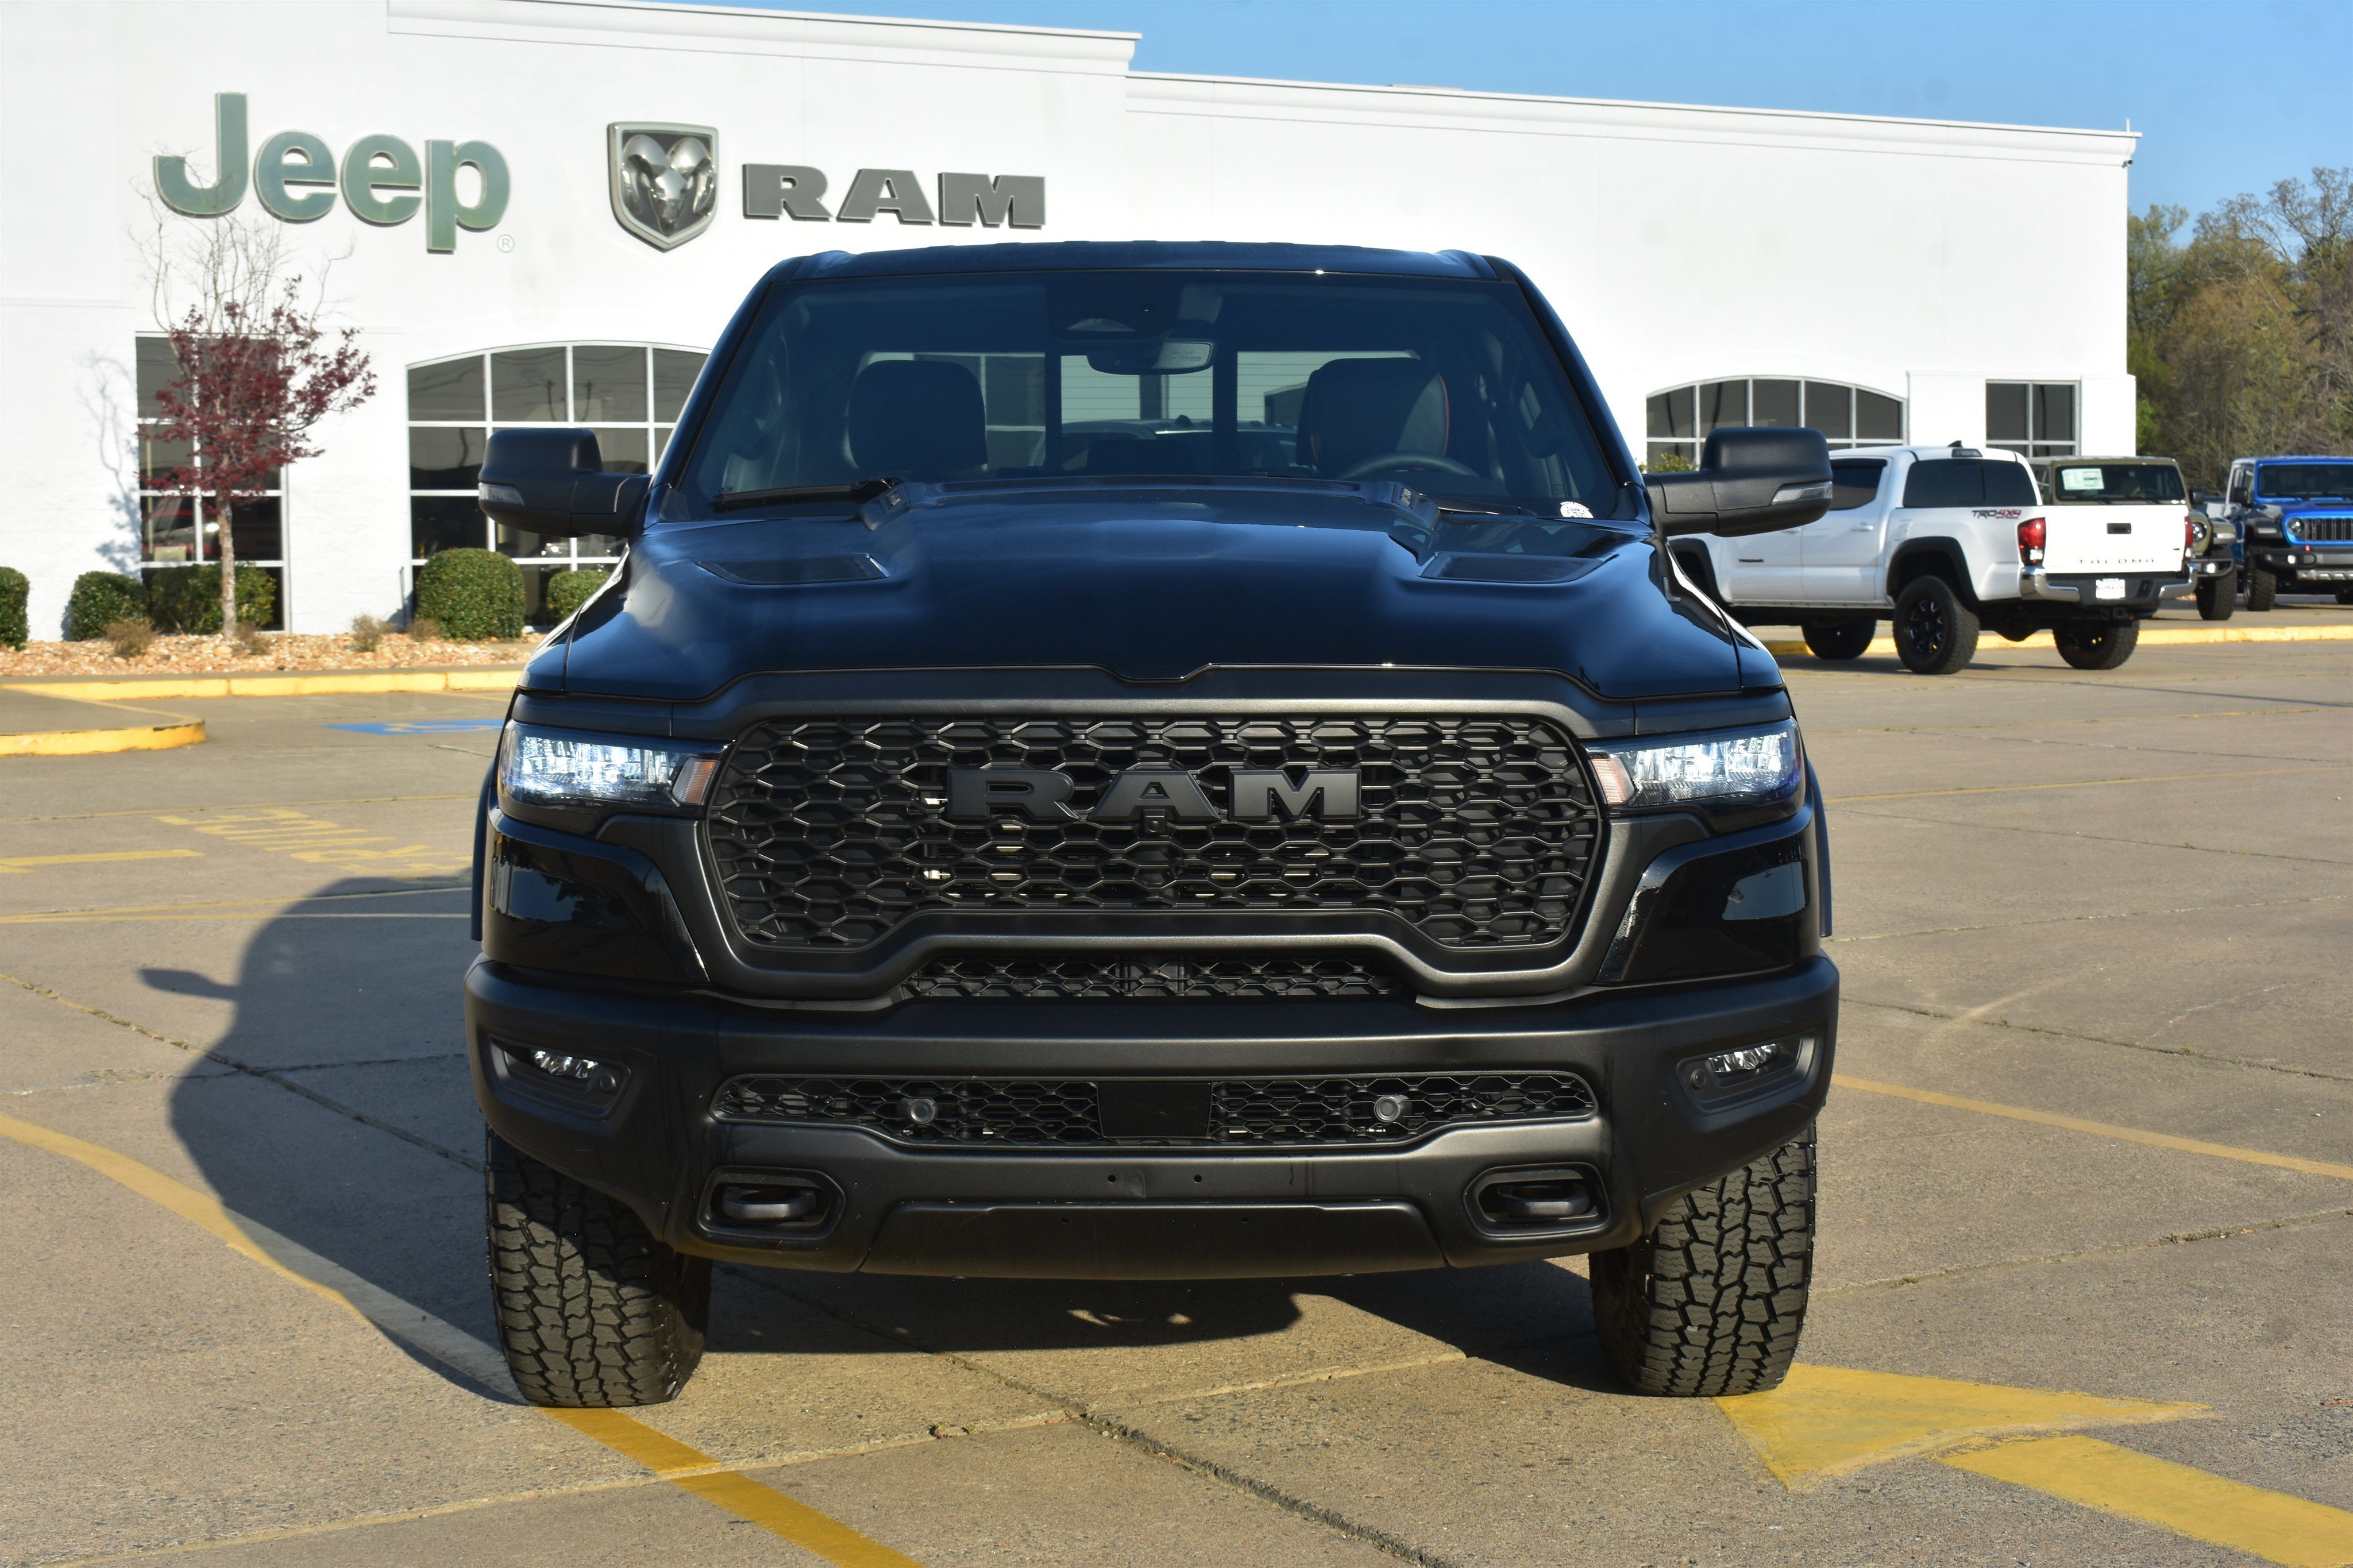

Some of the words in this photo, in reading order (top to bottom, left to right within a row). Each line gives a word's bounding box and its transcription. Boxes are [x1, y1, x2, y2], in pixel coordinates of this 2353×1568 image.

[153, 92, 510, 254] Jeep
[742, 163, 1047, 229] RAM
[947, 769, 1362, 821] RAM
